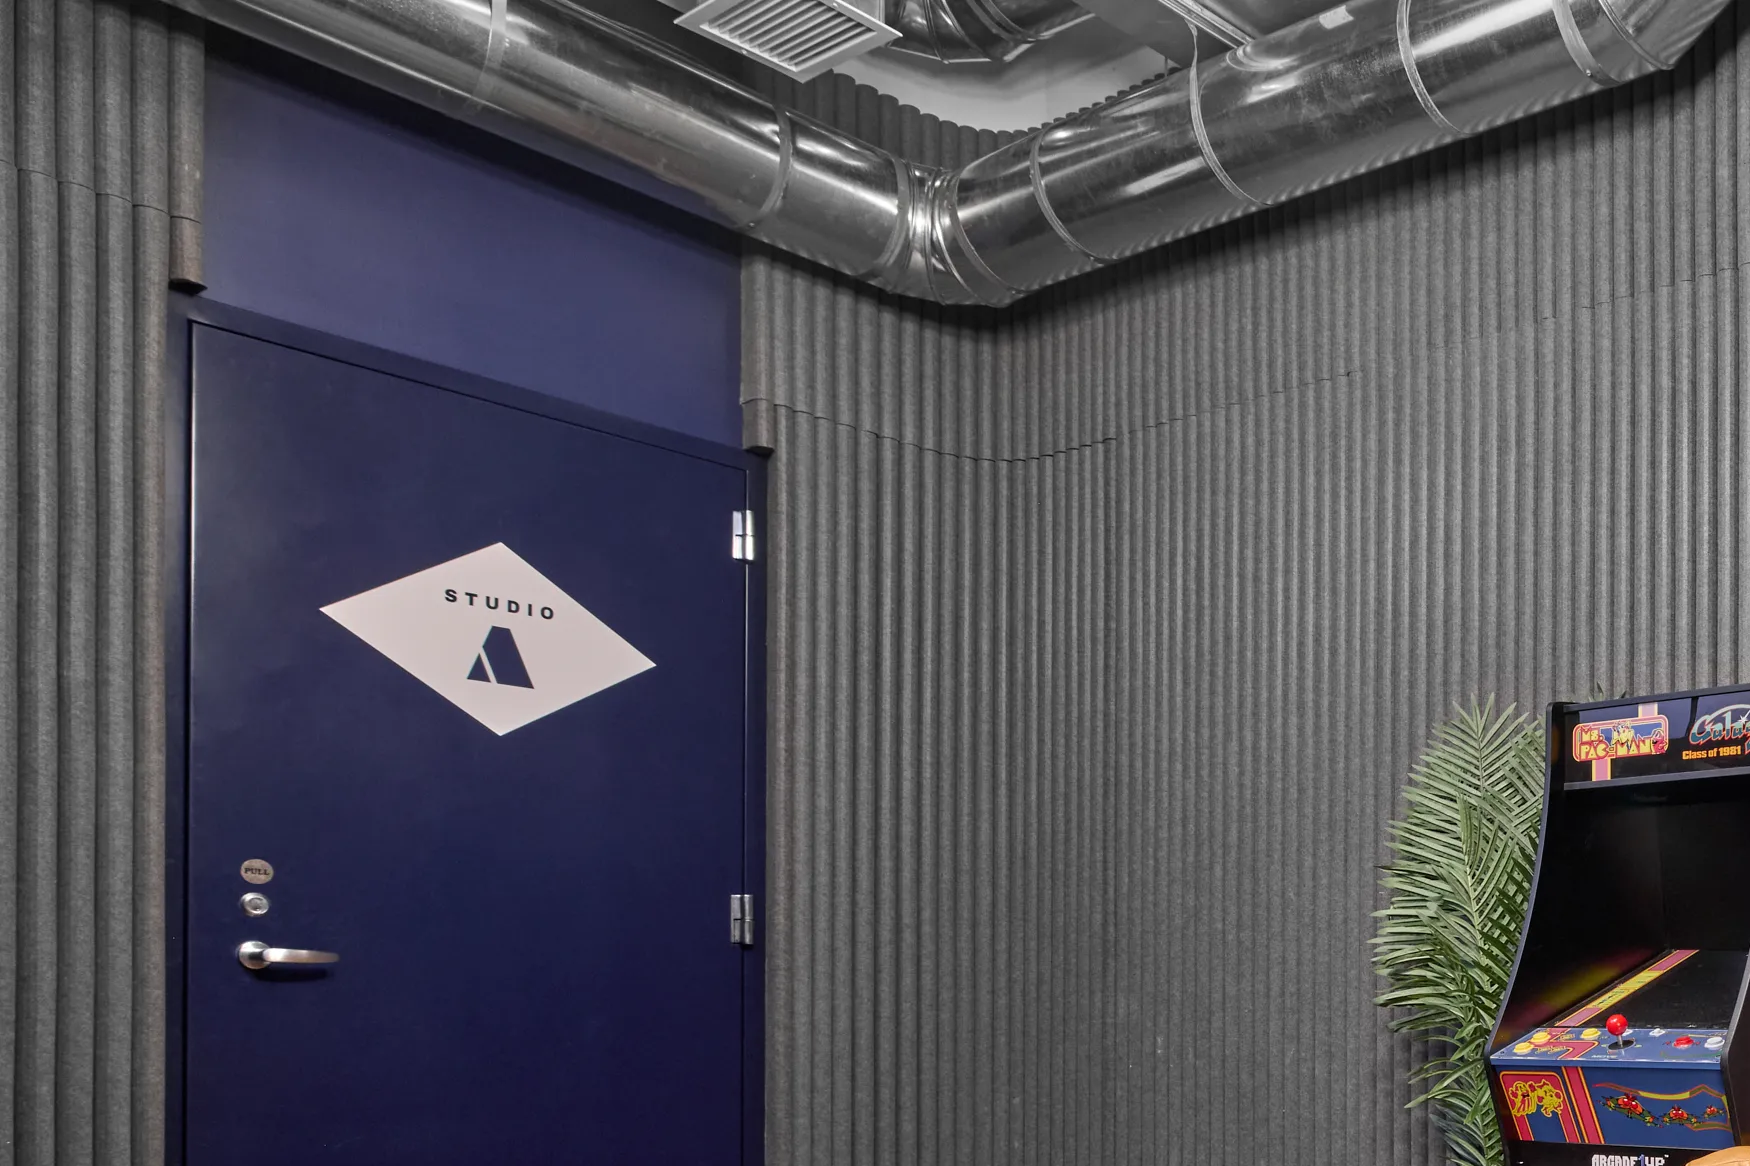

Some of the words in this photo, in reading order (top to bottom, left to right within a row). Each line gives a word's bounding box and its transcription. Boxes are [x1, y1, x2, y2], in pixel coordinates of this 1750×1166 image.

[444, 588, 555, 620] STUDIO
[1682, 750, 1707, 760] Class
[1708, 748, 1717, 758] of
[1719, 745, 1742, 756] 1981
[244, 867, 270, 876] PULL
